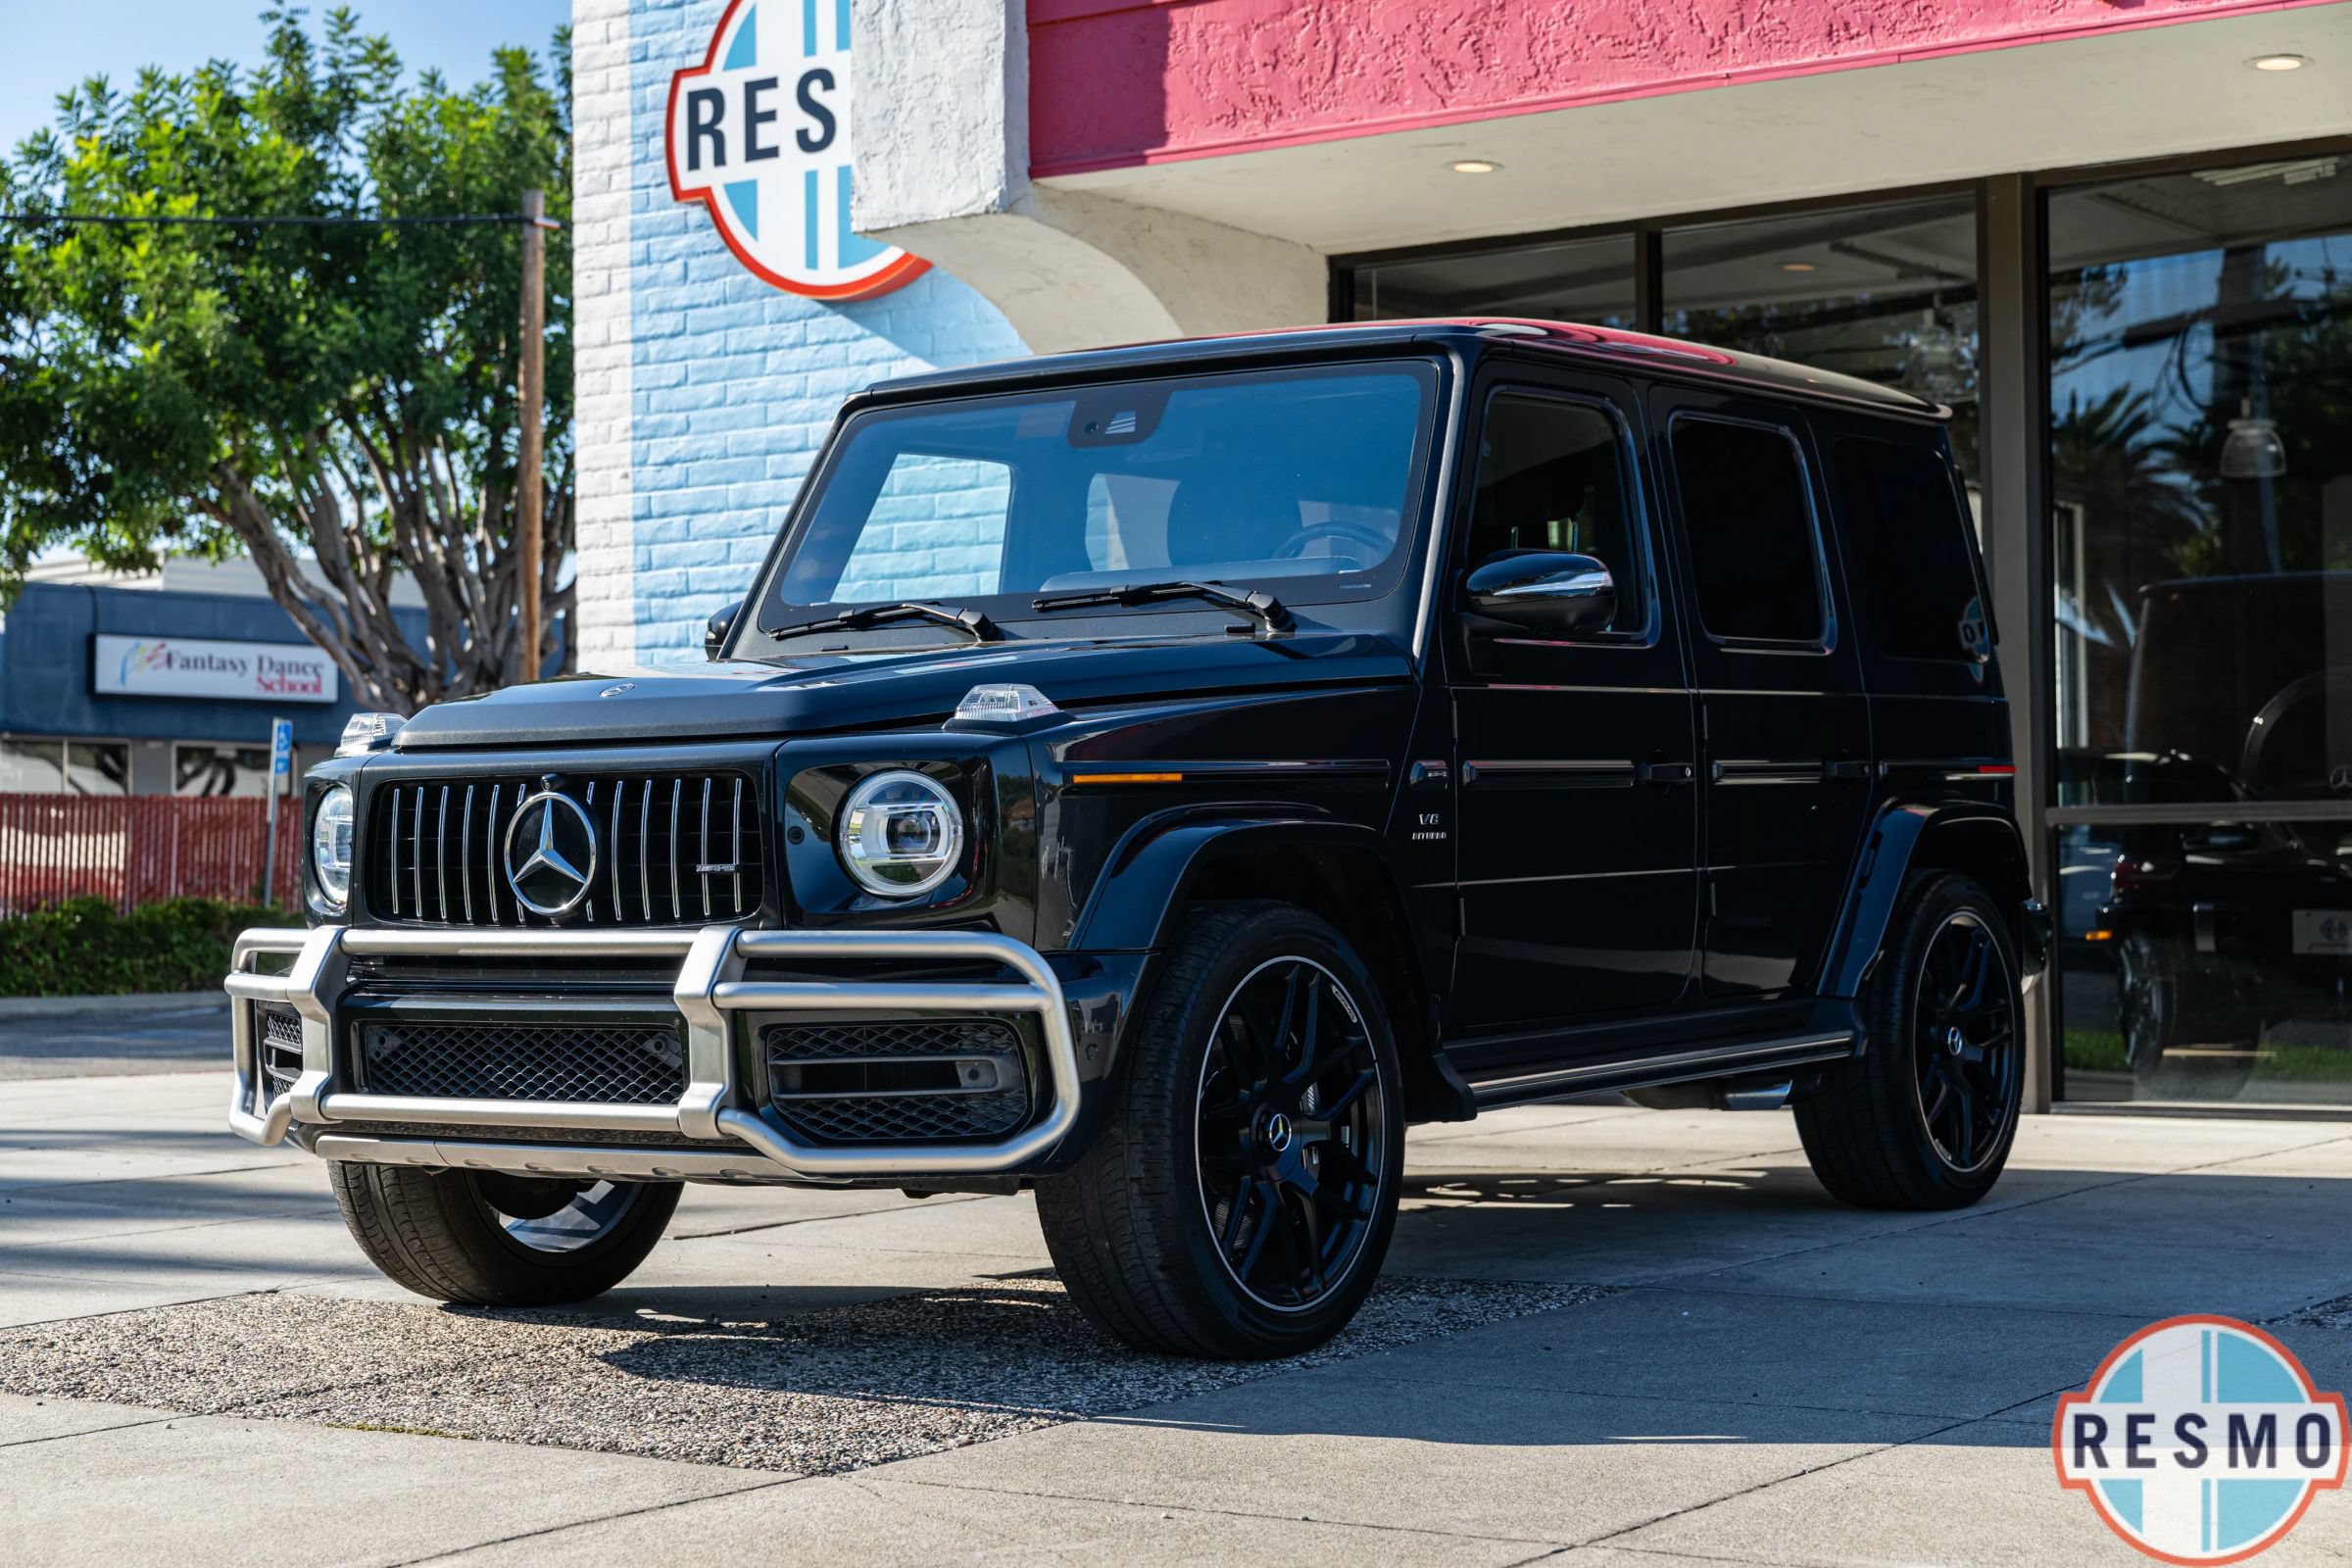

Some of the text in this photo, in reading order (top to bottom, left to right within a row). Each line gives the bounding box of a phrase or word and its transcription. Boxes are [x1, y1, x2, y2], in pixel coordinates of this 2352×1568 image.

[167, 651, 324, 678] Fantasy Dance
[256, 674, 322, 696] School
